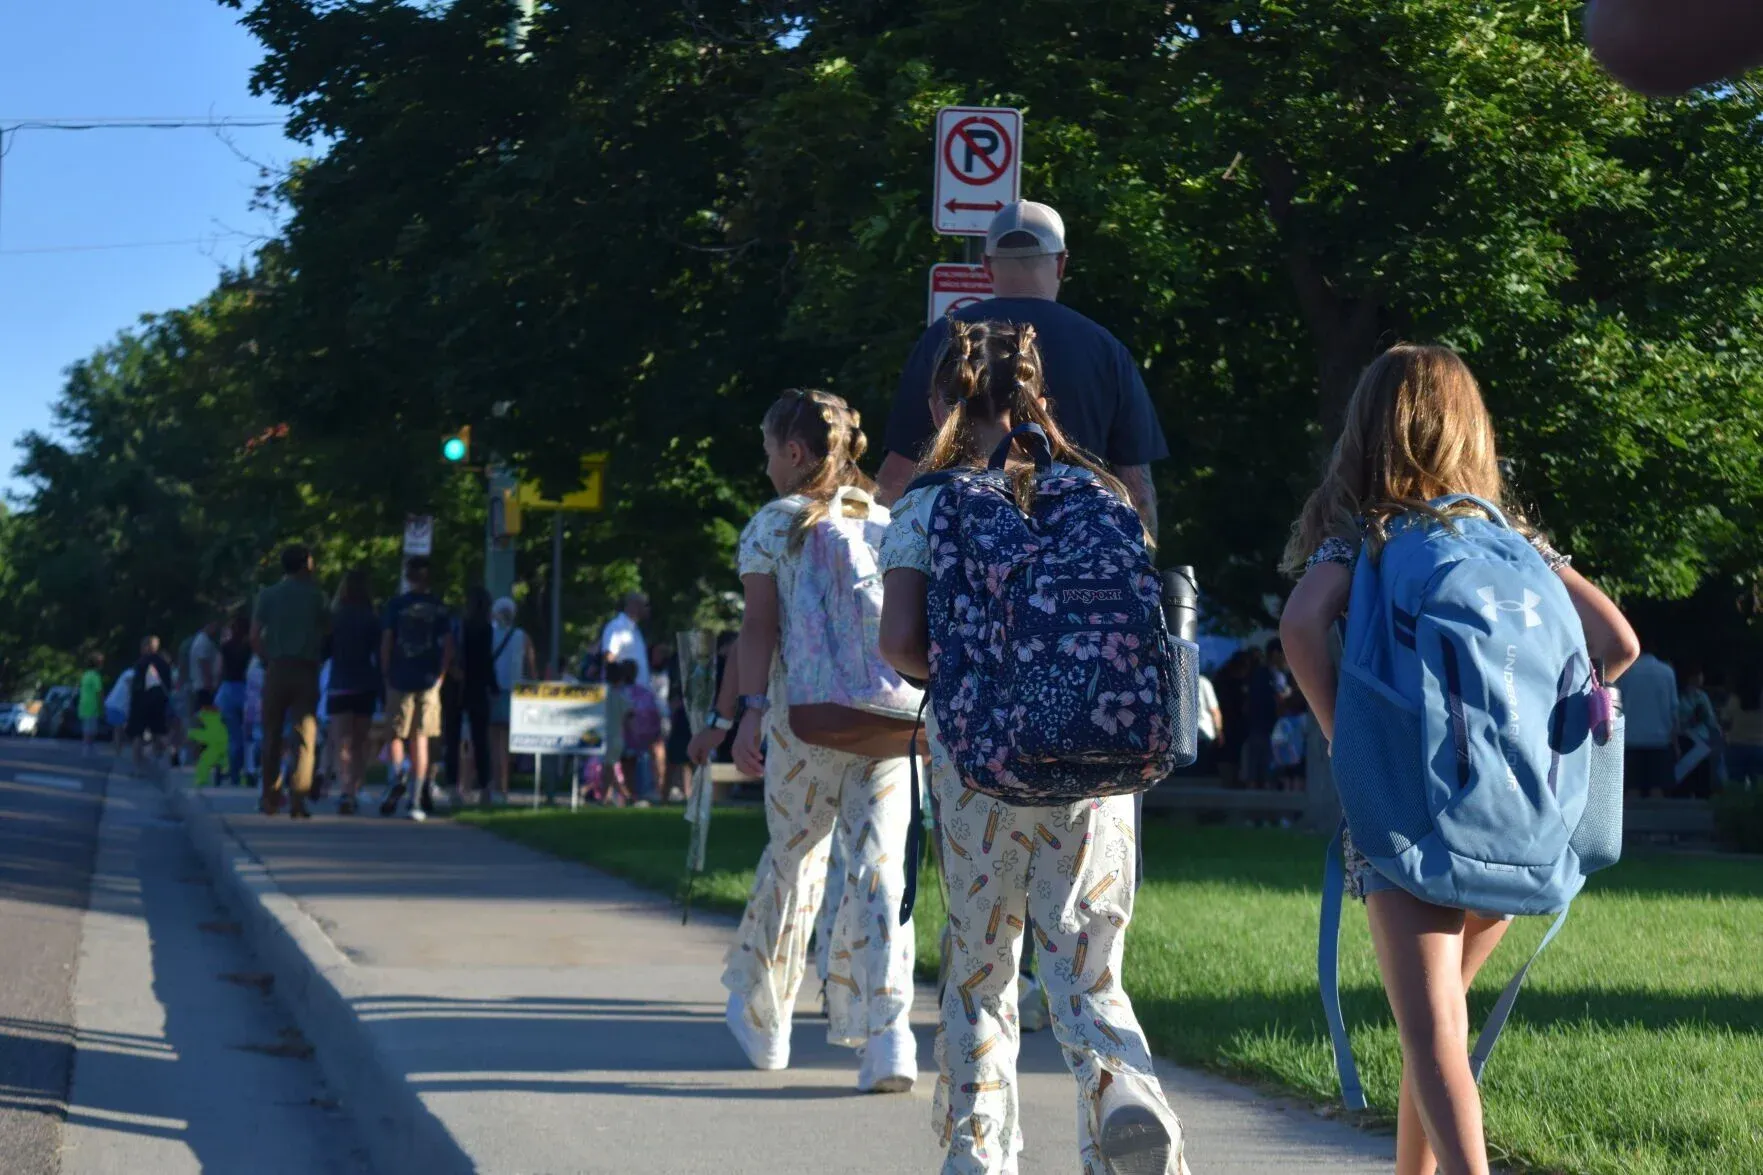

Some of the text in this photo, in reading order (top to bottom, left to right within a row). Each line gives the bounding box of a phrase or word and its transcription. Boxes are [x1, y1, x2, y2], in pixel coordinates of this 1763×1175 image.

[964, 129, 999, 172] P
[1062, 588, 1121, 604] JANSPORT
[1504, 644, 1518, 708] UNDER
